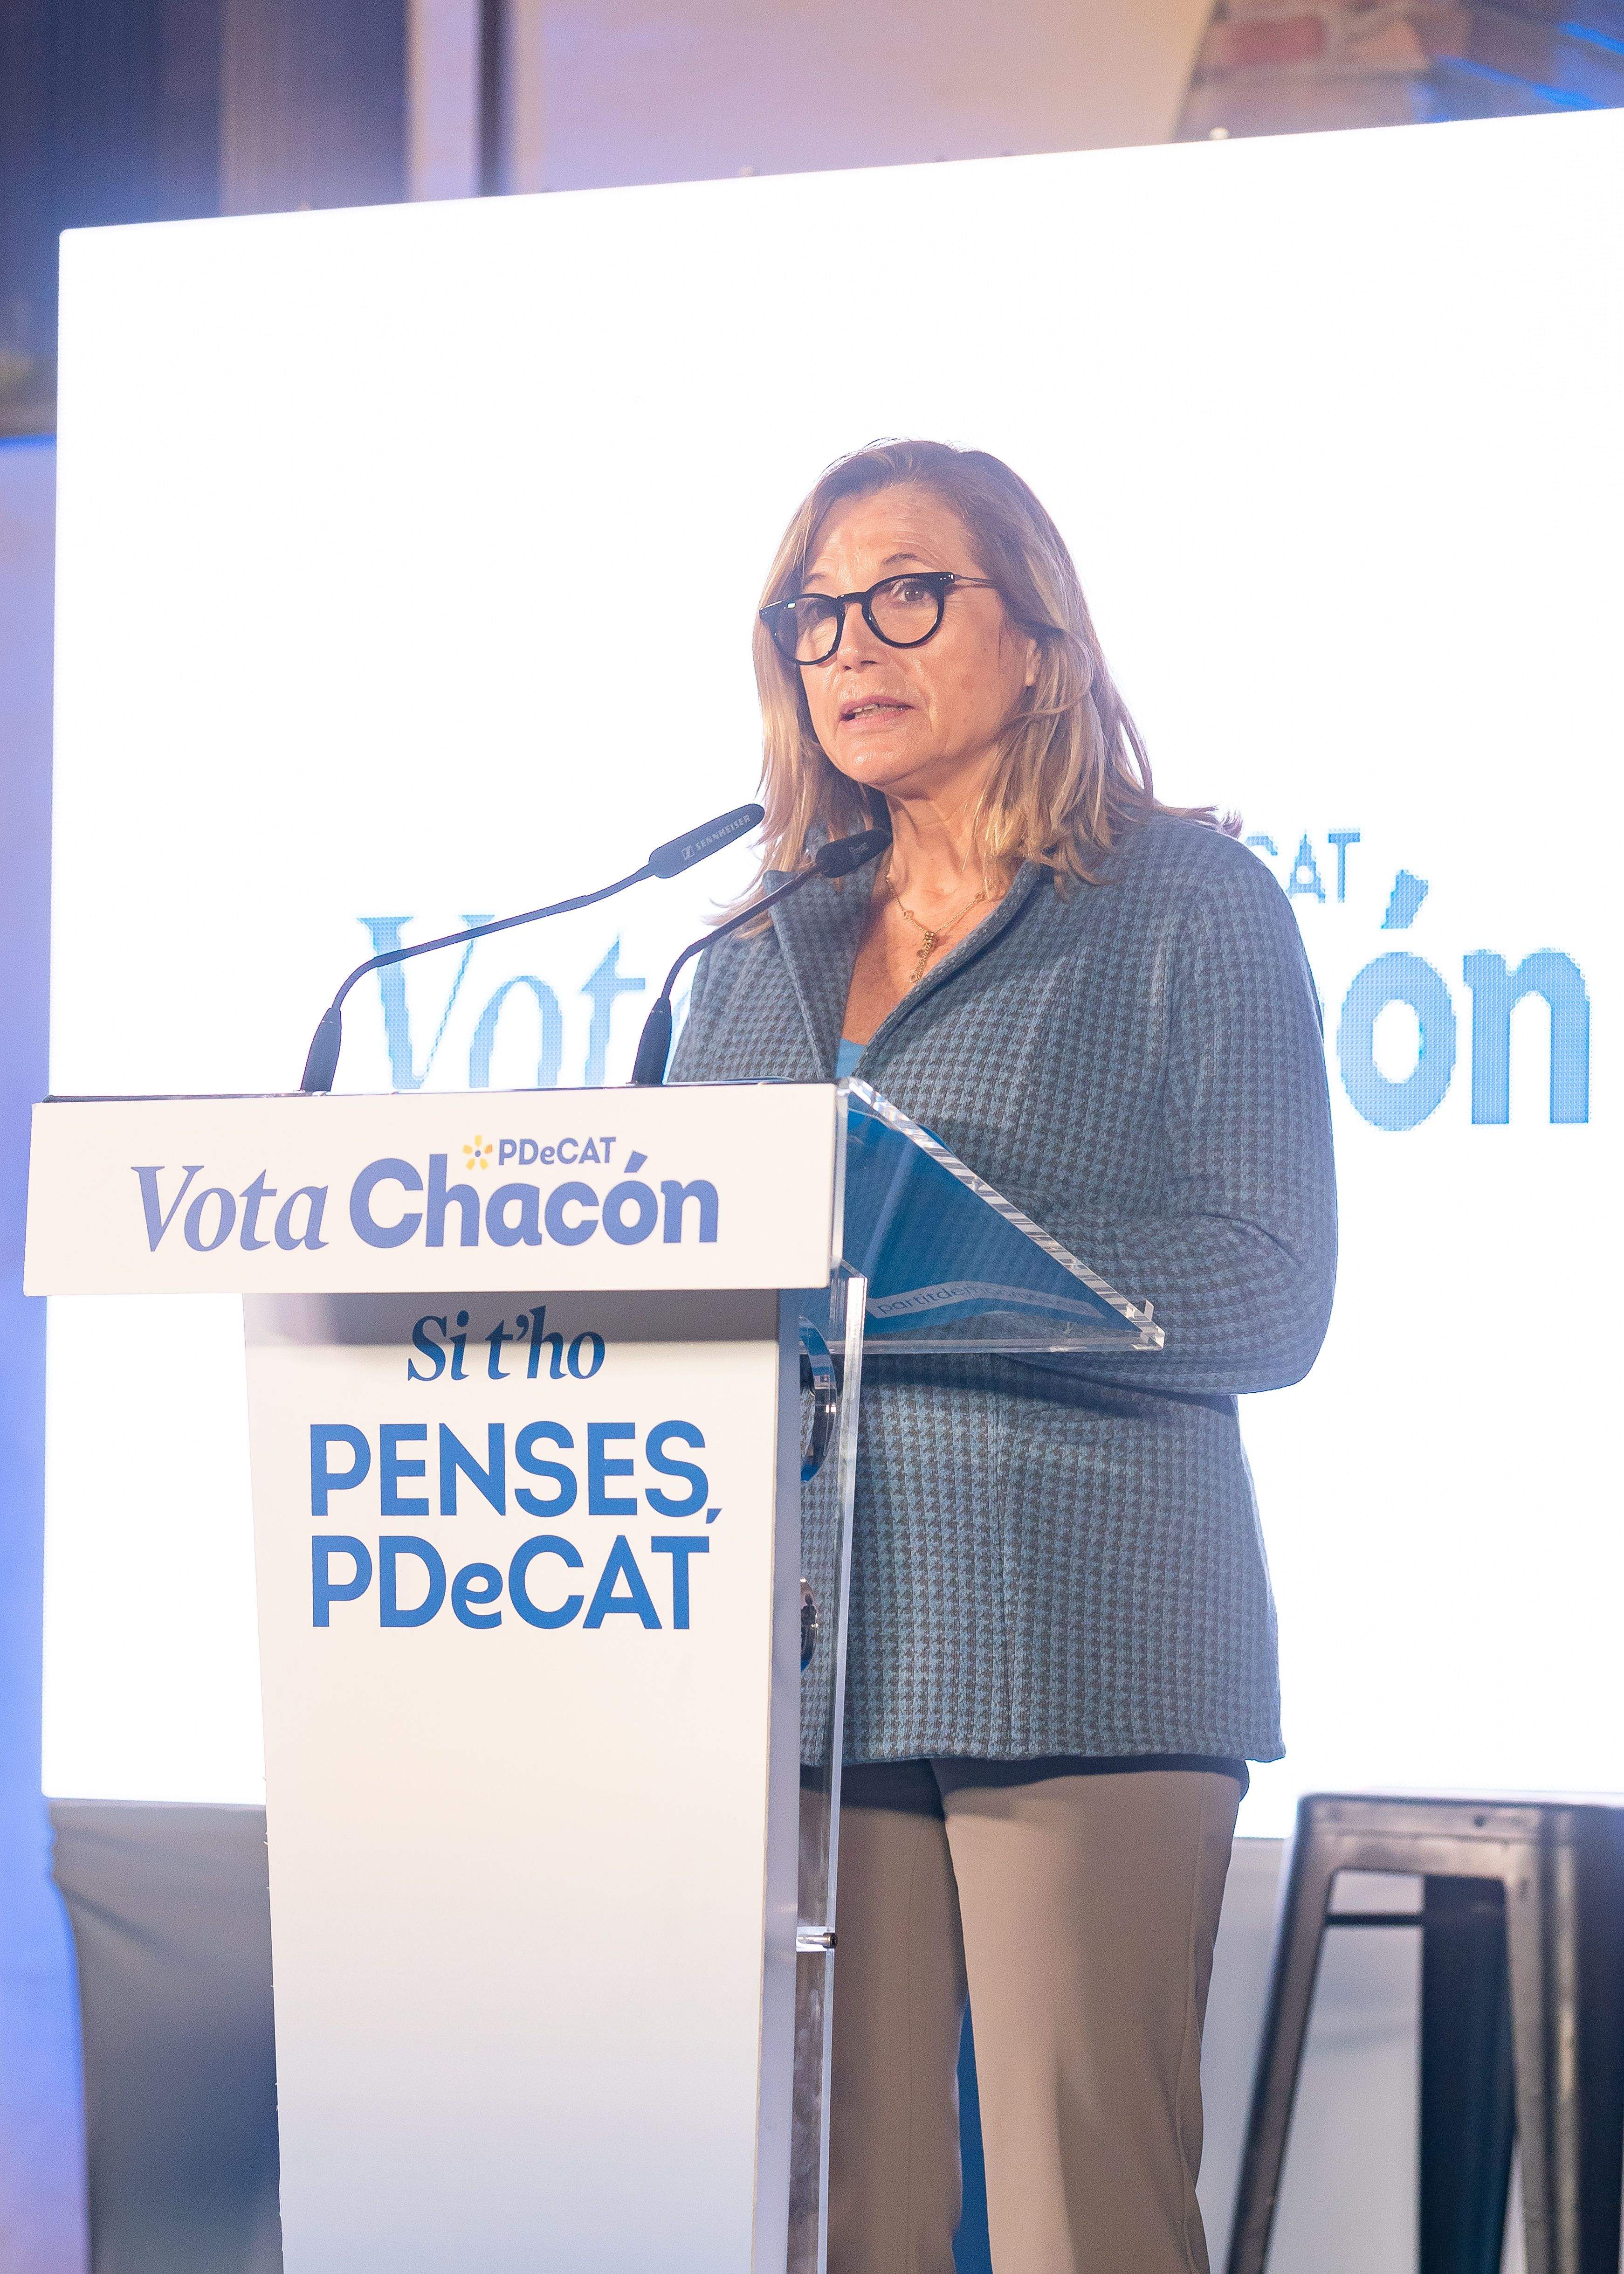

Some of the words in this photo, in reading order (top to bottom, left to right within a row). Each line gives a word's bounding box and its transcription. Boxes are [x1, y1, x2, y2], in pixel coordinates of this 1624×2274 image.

[695, 814, 750, 851] SENNHEISER
[357, 914, 691, 1089] Vot
[1336, 869, 1590, 1132] ón
[500, 1137, 616, 1165] PDeCAT
[131, 1166, 329, 1251] Vota
[351, 1152, 718, 1248] Chacón
[408, 1310, 468, 1381] Si
[310, 1420, 723, 1524] PENSES,
[312, 1535, 709, 1629] PDeCAT
